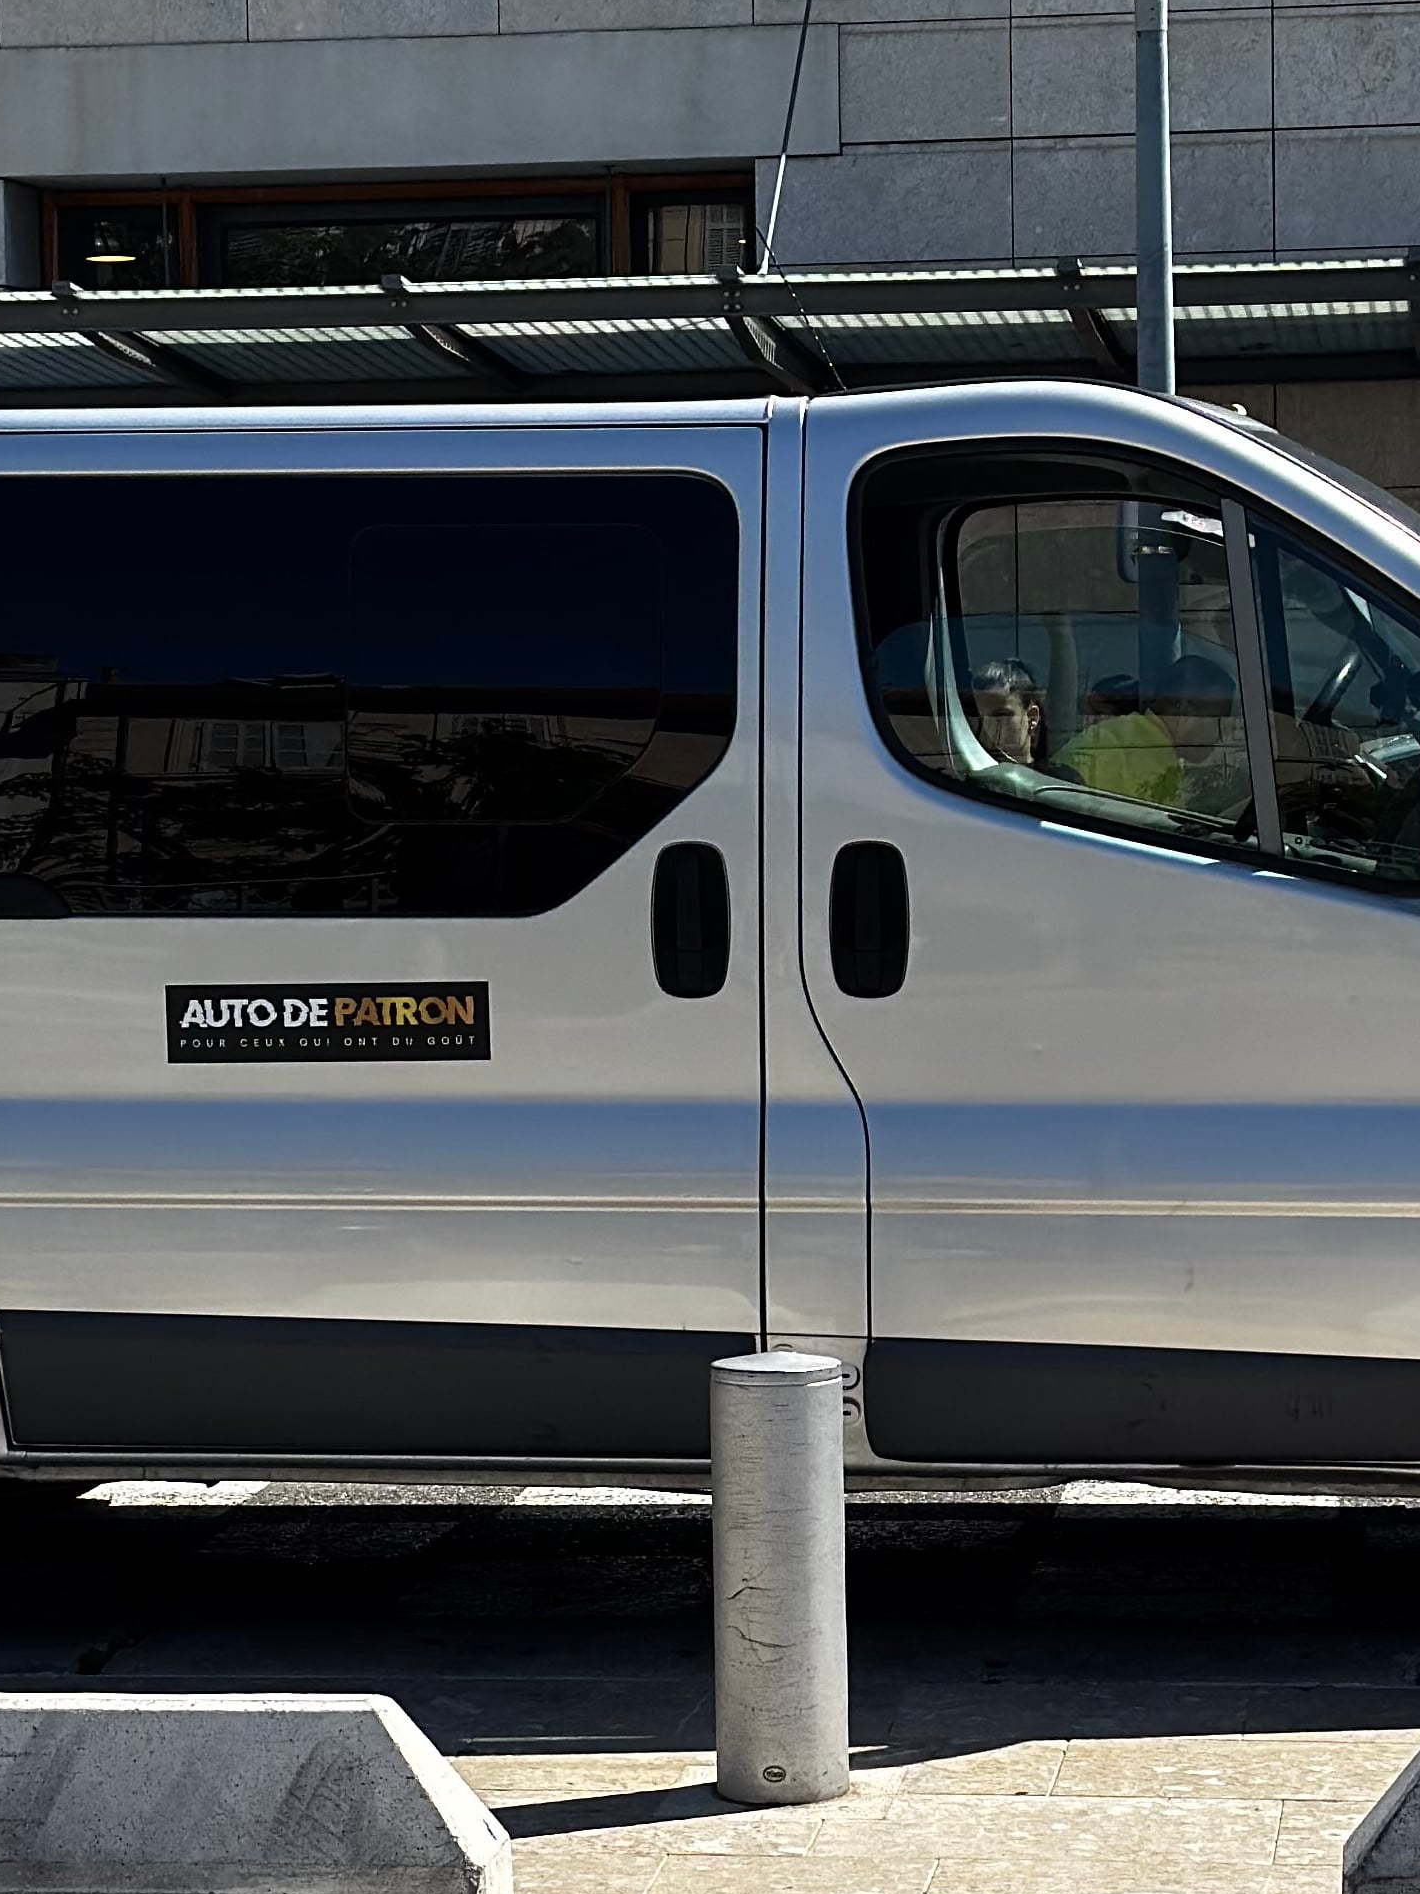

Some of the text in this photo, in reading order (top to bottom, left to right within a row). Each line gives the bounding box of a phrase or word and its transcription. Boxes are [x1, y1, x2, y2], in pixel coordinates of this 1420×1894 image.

[180, 996, 475, 1028] AUTO DE PATRON
[180, 1038, 226, 1048] POUR
[239, 1038, 286, 1048] CEUX
[343, 1037, 378, 1047] ONT
